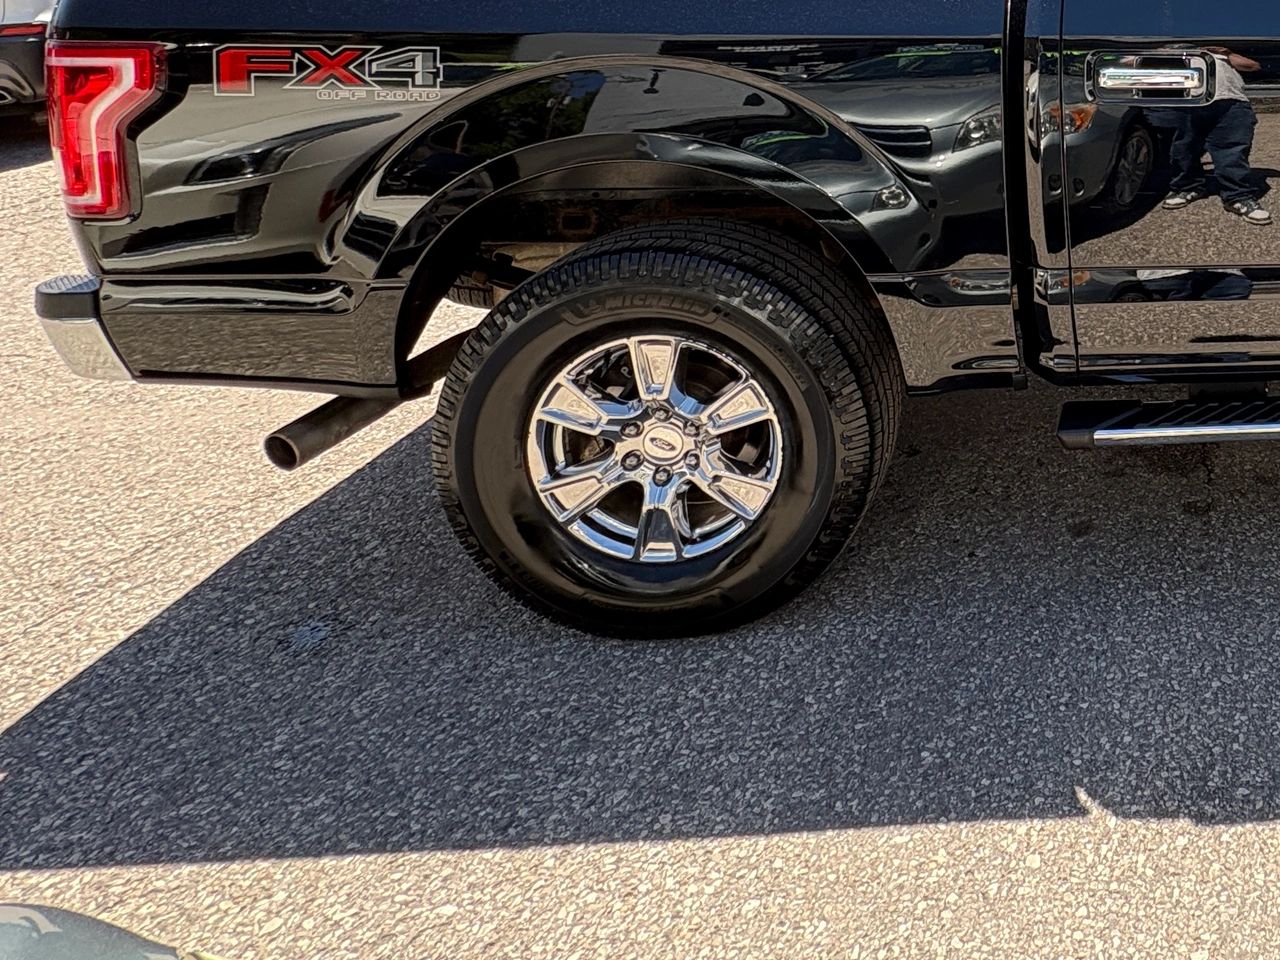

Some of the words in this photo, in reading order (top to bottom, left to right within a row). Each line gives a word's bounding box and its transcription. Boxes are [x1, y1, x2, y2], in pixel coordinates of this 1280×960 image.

[213, 44, 443, 96] FX4
[317, 90, 366, 100] OFF
[375, 90, 440, 101] ROAD
